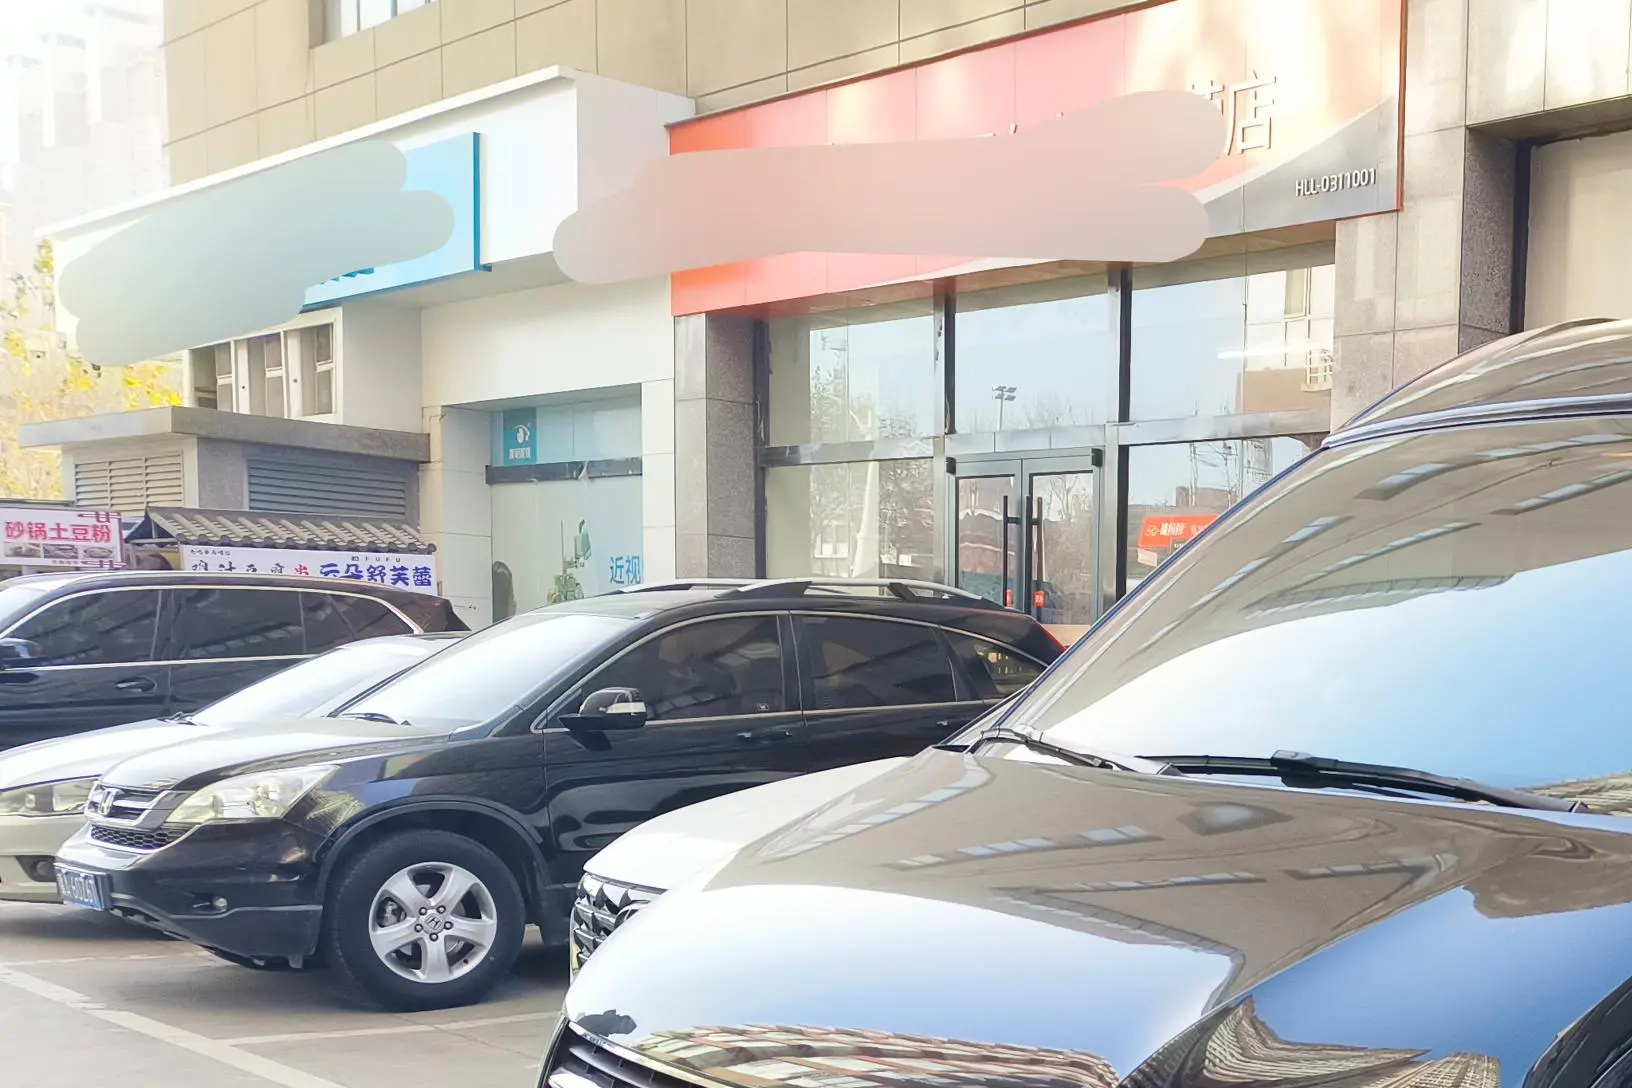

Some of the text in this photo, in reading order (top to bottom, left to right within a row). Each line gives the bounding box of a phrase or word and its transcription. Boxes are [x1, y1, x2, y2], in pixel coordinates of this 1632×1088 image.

[1192, 70, 1277, 157] 店
[1295, 167, 1377, 197] HLL-0311001
[4, 521, 111, 543] 砂锅土豆粉
[609, 555, 642, 585] 近视
